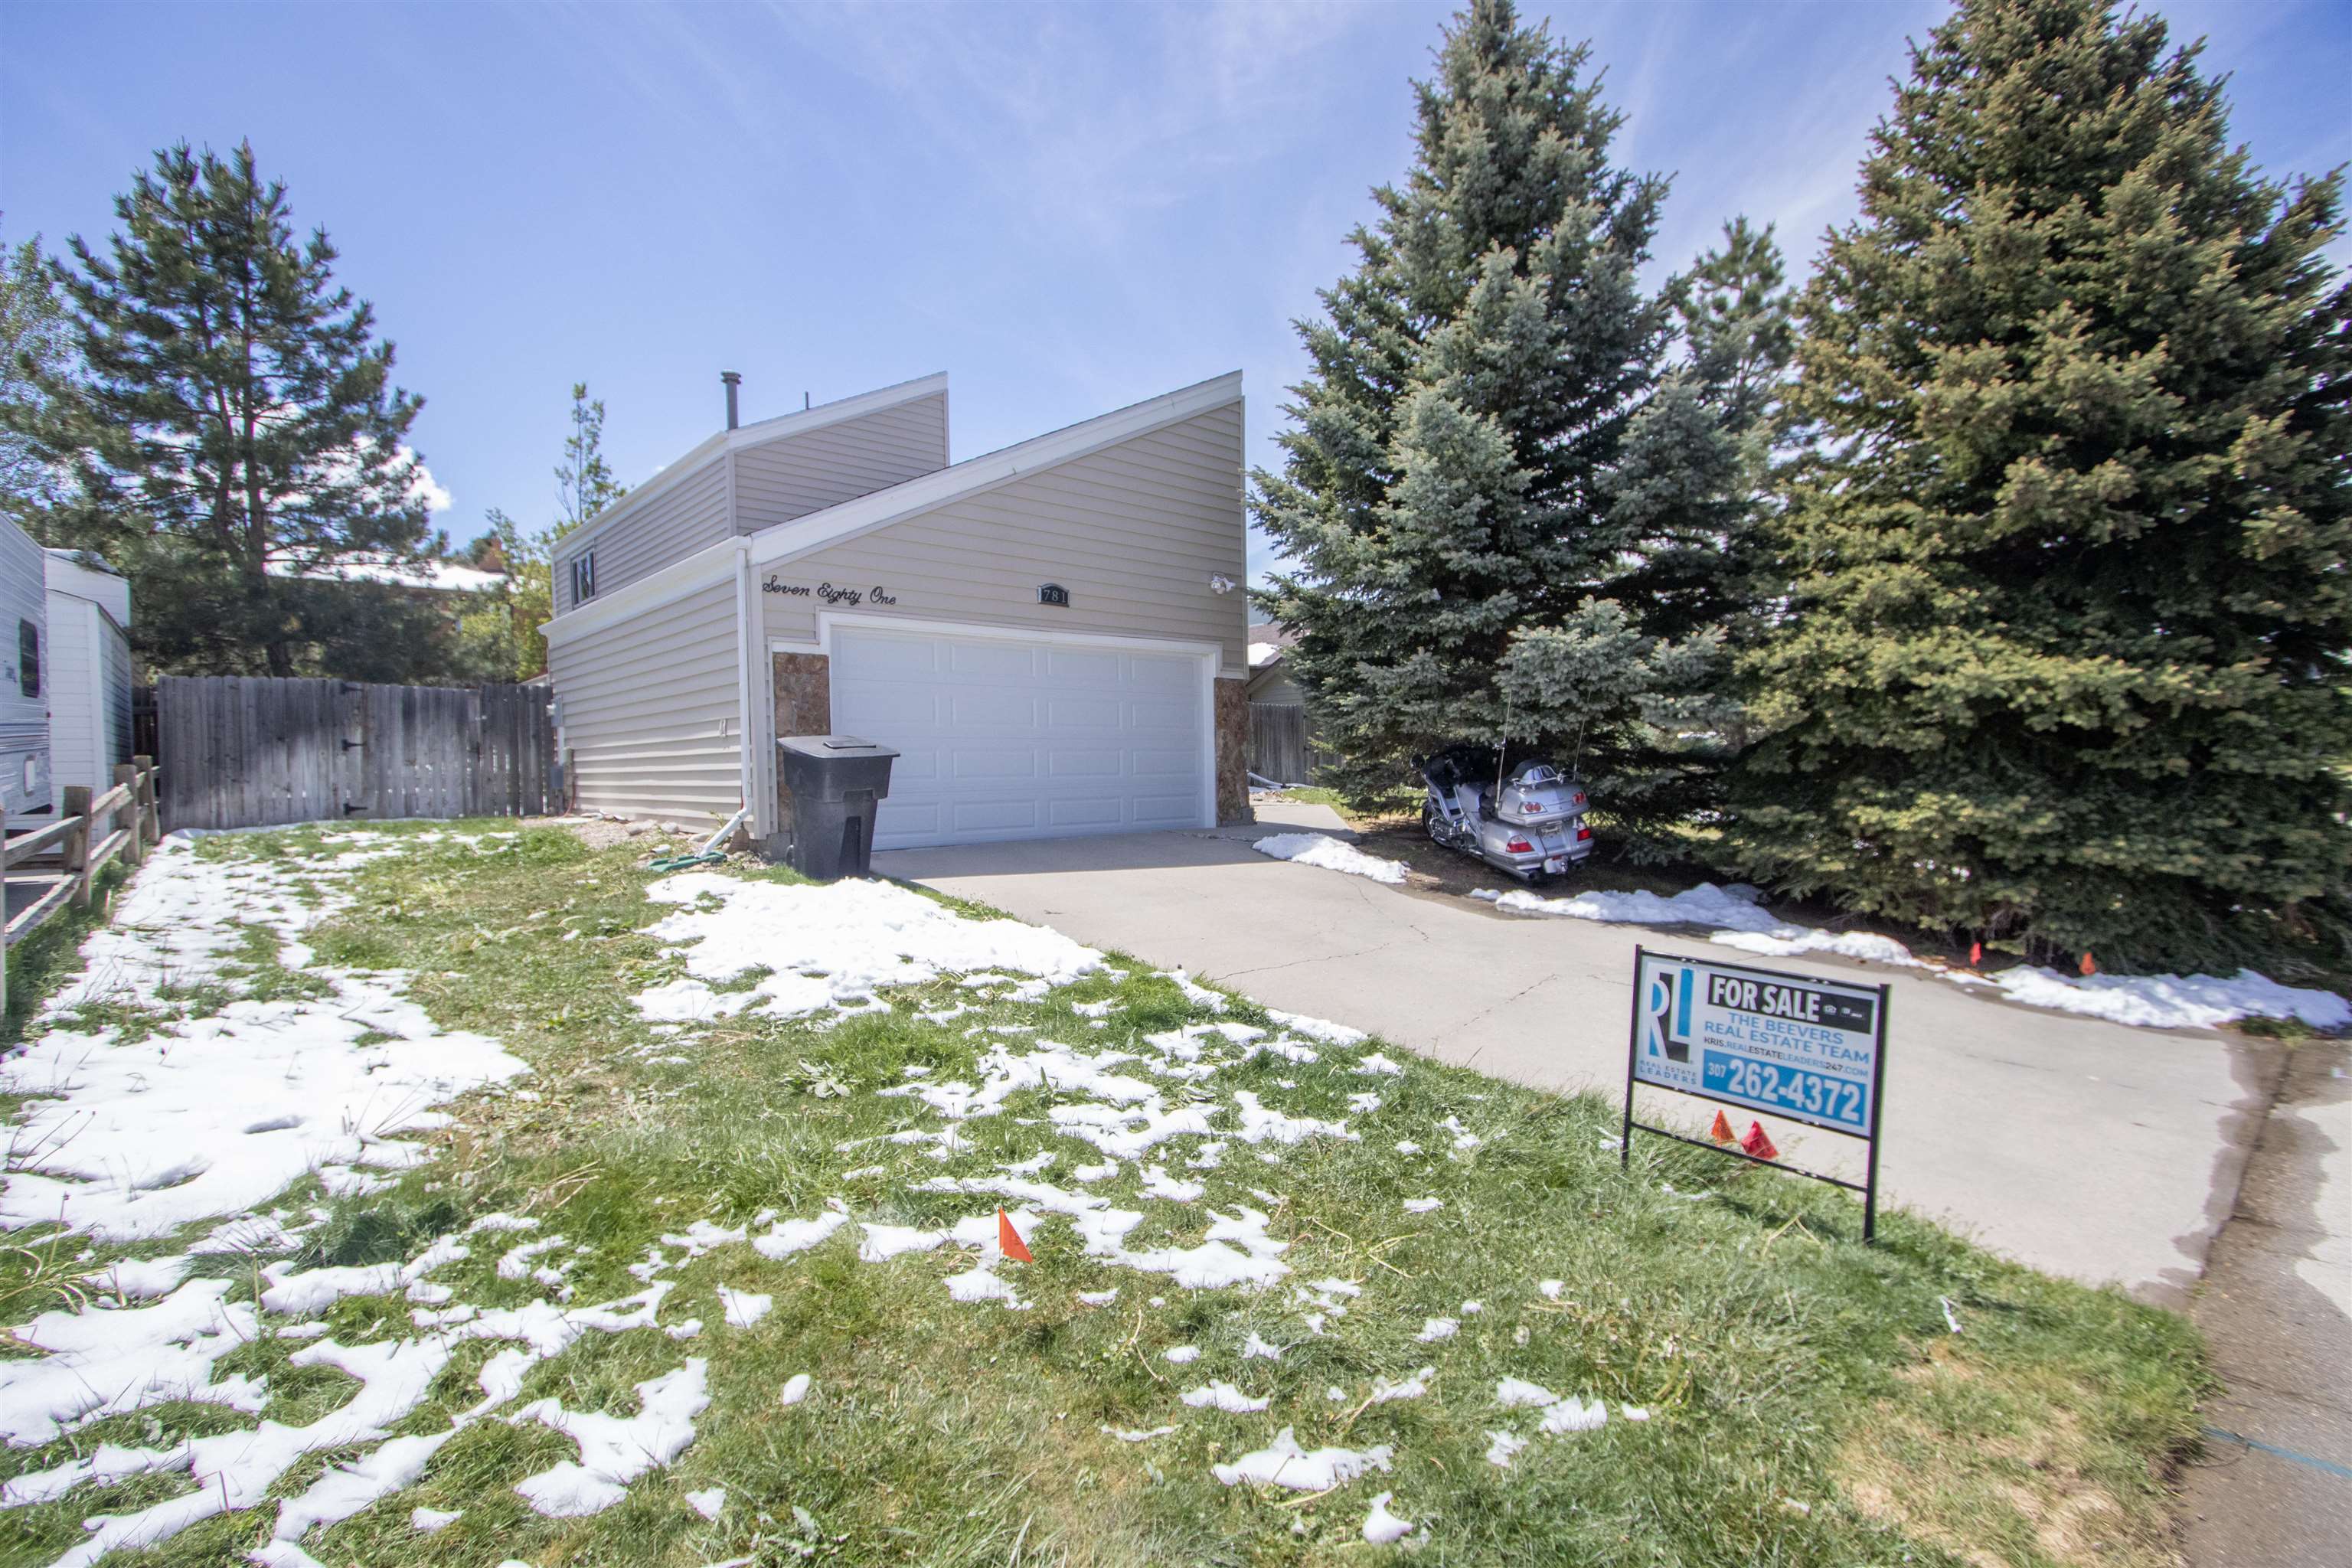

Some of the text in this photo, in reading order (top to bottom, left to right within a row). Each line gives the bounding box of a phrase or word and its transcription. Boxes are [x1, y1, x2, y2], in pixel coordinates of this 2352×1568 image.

[762, 574, 897, 606] Seven Eighty One
[1044, 590, 1067, 603] 781
[1712, 976, 1821, 1022] FOR SALE
[1705, 1021, 1870, 1065] REAL ESTATE TEAM
[1727, 1011, 1844, 1044] THE BEEVERS
[1640, 1060, 1697, 1077] REAL ESTATE
[1640, 1067, 1697, 1085] LEADERS
[1708, 1058, 1861, 1122] 307 262-4372
